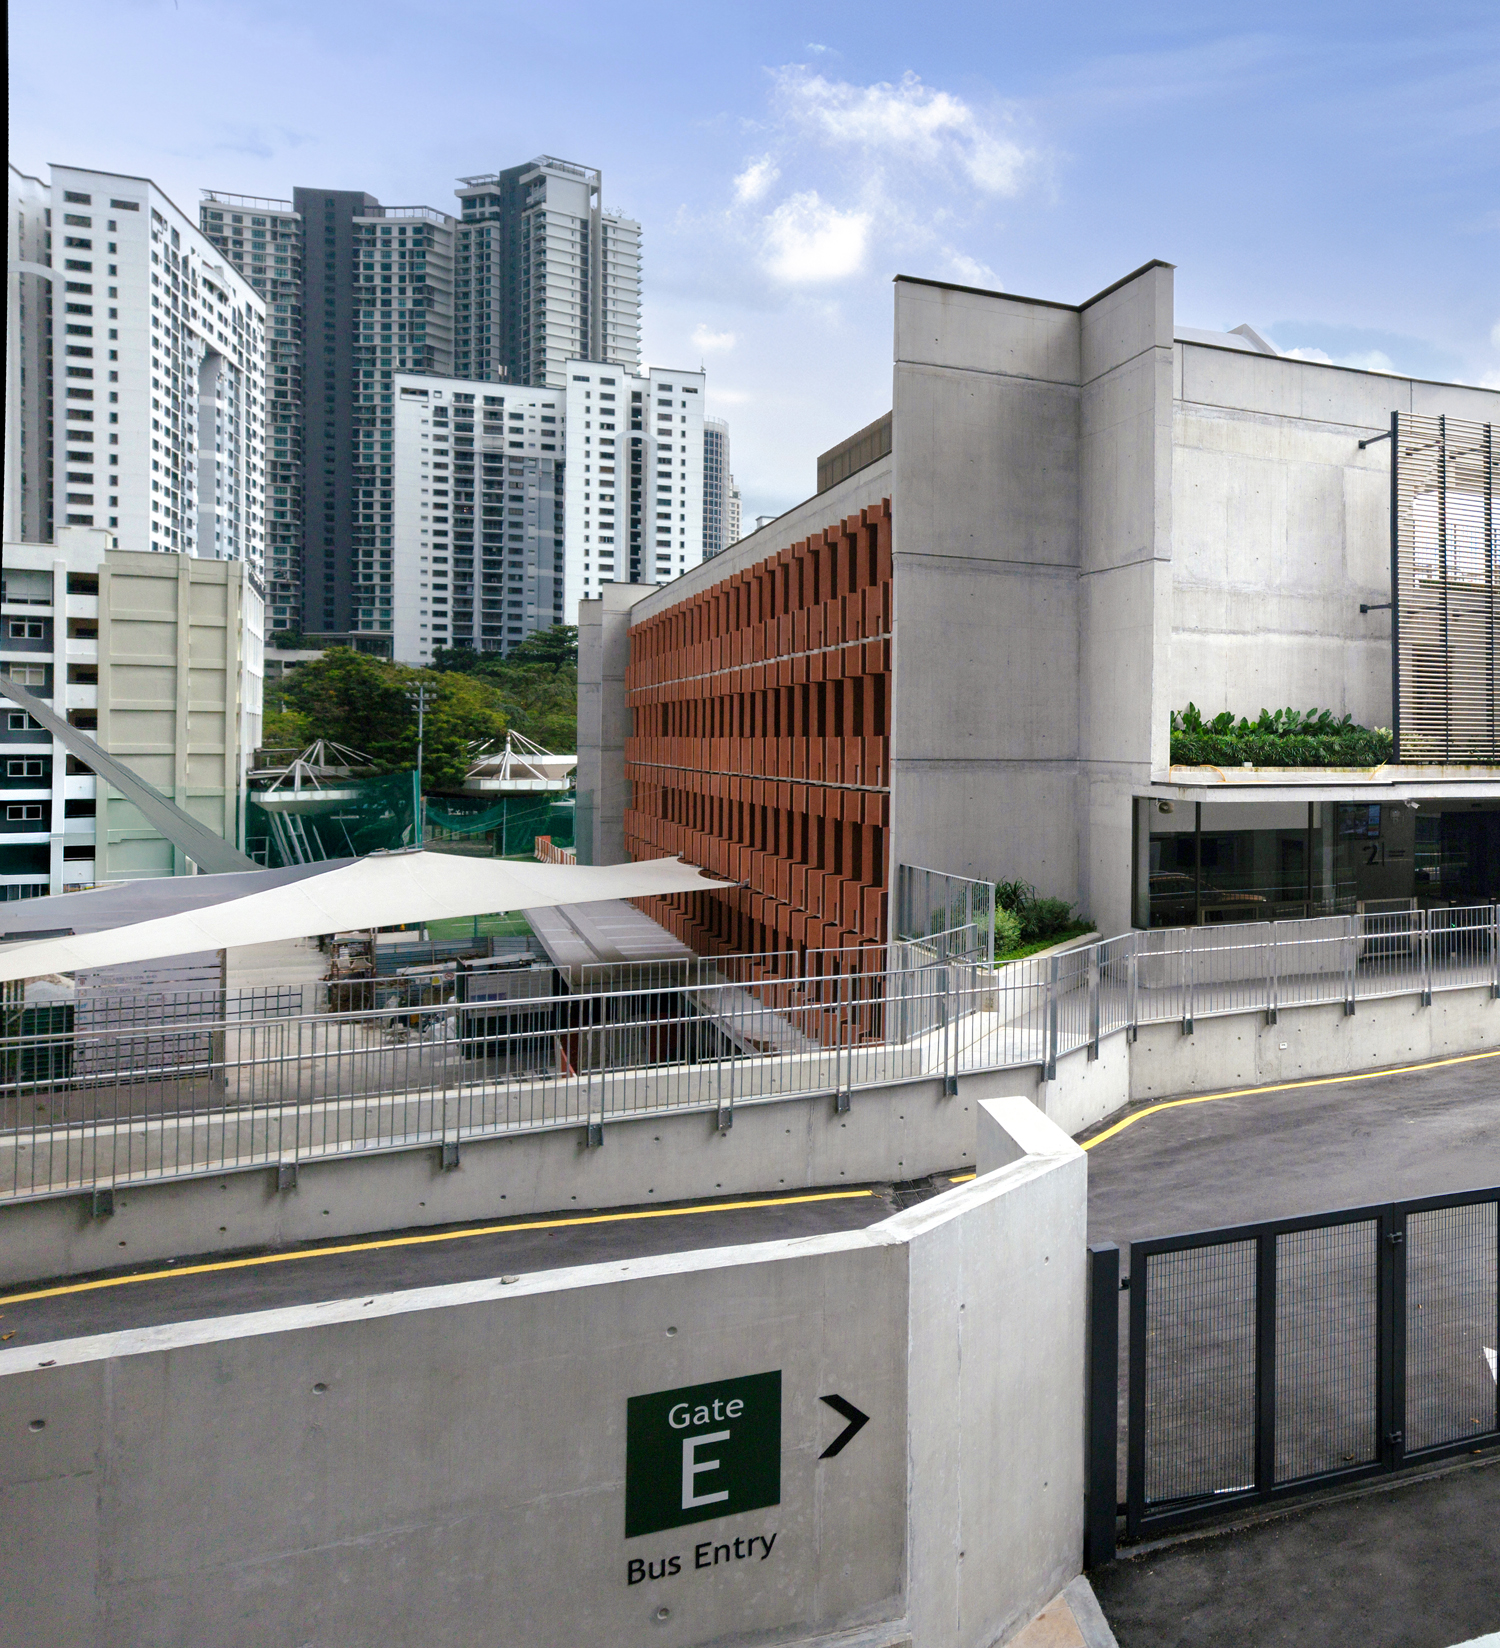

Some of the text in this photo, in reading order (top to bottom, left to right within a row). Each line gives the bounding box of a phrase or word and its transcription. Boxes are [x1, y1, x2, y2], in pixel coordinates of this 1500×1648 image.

[668, 1398, 745, 1429] Gate
[681, 1430, 731, 1510] E
[627, 1532, 778, 1586] Bus Entry
